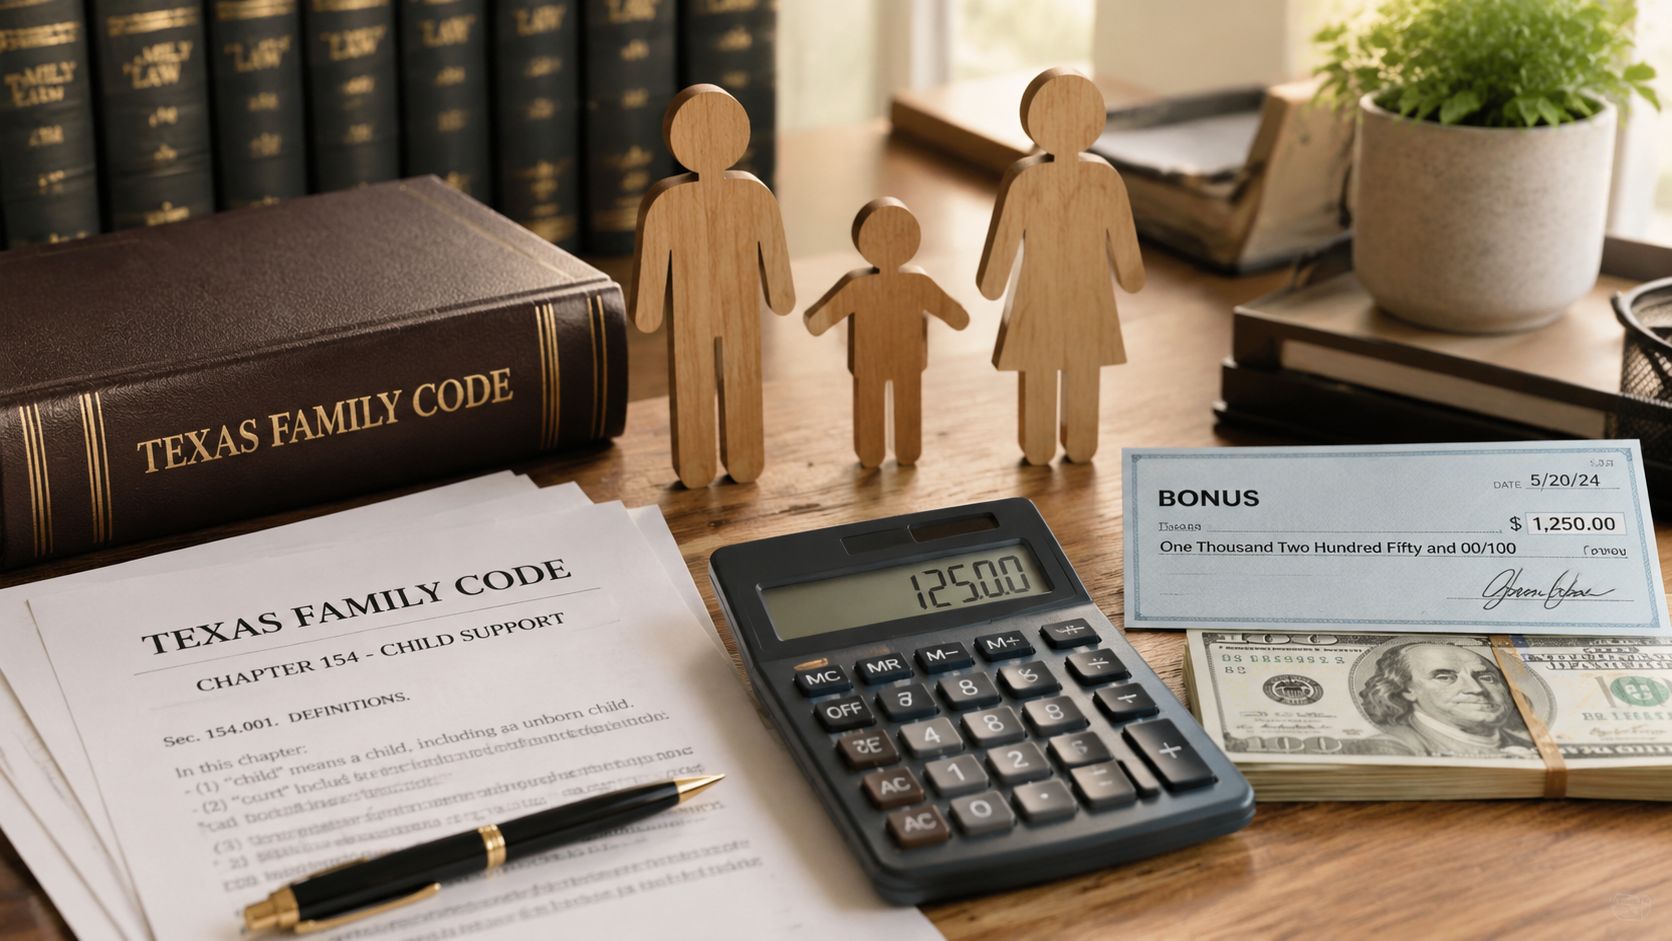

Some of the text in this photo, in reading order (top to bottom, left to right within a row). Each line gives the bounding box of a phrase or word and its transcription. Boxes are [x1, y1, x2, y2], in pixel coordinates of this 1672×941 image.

[137, 367, 514, 474] TEXAS FAMILY CODE
[1158, 489, 1260, 508] BONUS
[1493, 473, 1601, 491] DATE 5/20/24
[1509, 516, 1616, 533] $ 1,250.00
[1160, 540, 1517, 557] One Thousand Two Hundred Fifty and 00/100
[141, 557, 572, 656] TEXAS FAMILY CODE
[196, 658, 315, 692] CHAPTER
[320, 650, 360, 669] 154
[380, 632, 455, 658] CHILD
[460, 611, 566, 643] SUPPORT
[805, 670, 841, 686] MC
[866, 659, 902, 674] MR
[826, 701, 863, 719] OFF
[958, 679, 978, 696] 8
[163, 691, 411, 748] Sec. 154.001. DEFINITIONS.
[924, 726, 941, 744] 4
[983, 714, 1005, 732] 8
[174, 744, 308, 779] In this chapter:
[195, 779, 220, 796] (1)
[289, 754, 347, 776] means
[351, 754, 361, 765] a
[417, 724, 498, 750] including
[523, 707, 585, 730] unborn
[588, 698, 635, 717] child.
[881, 750, 1030, 795] AC 1 2
[202, 799, 228, 815] (2)
[904, 800, 992, 833] AC 0
